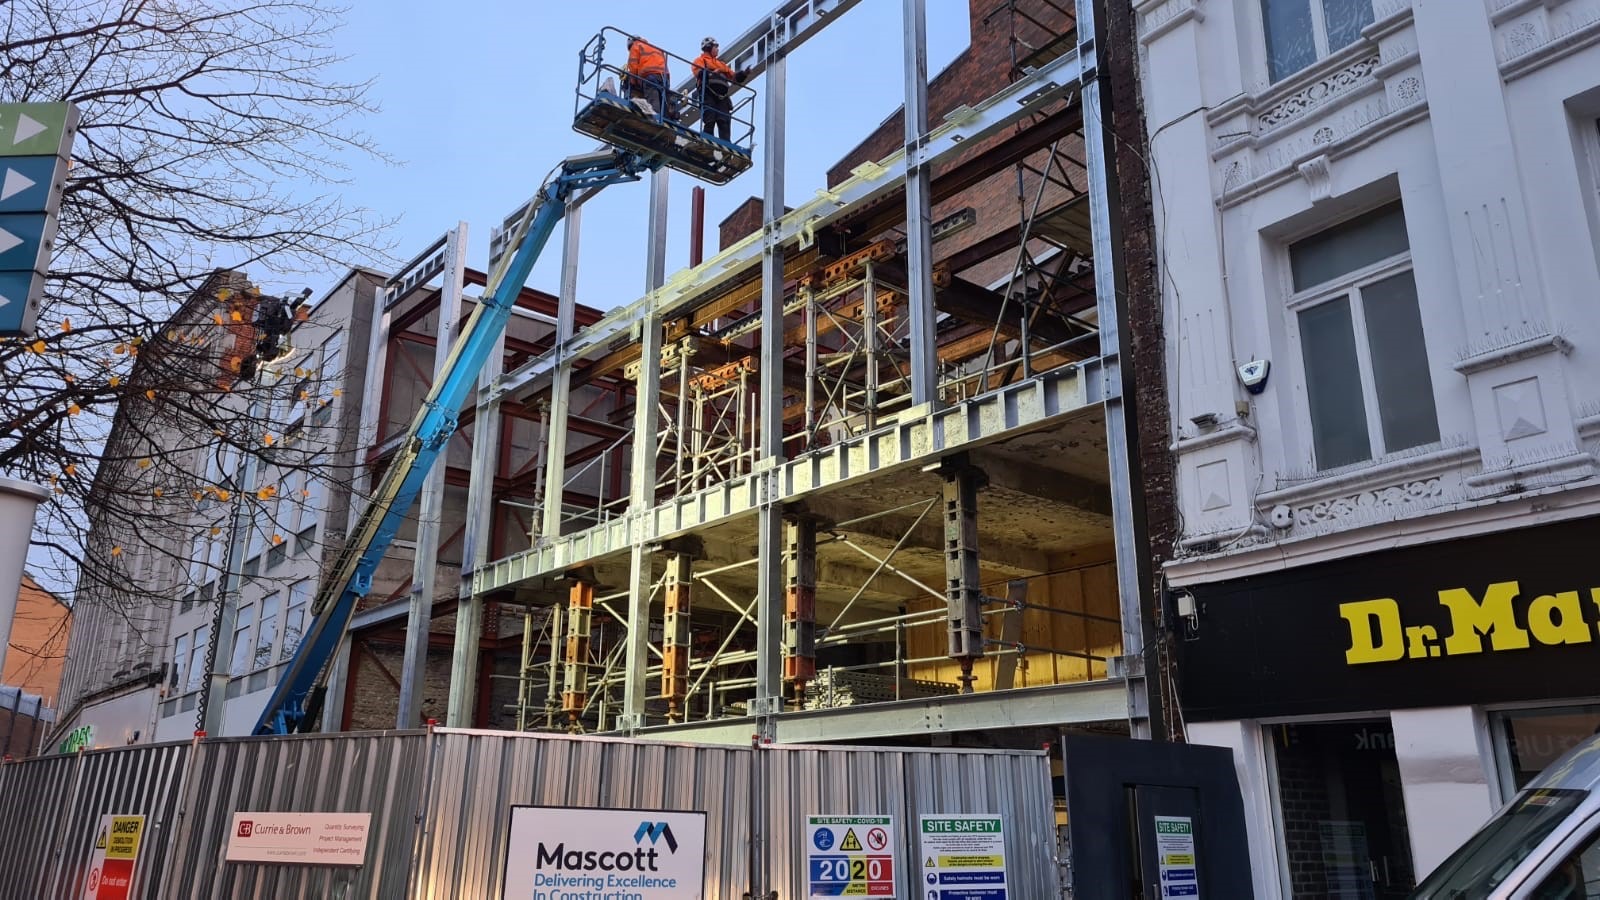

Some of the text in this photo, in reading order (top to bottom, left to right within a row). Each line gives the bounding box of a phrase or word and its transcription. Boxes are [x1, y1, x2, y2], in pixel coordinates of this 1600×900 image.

[1339, 581, 1600, 665] Dr.Ma
[112, 821, 139, 833] DANGER
[254, 823, 311, 835] Currie & Brown
[927, 820, 996, 832] SITE SAFETY
[1159, 822, 1189, 833] SITE SAFETY
[536, 842, 659, 872] Mascott
[534, 873, 676, 891] Delivering Excellence
[533, 889, 643, 900] In Construction
